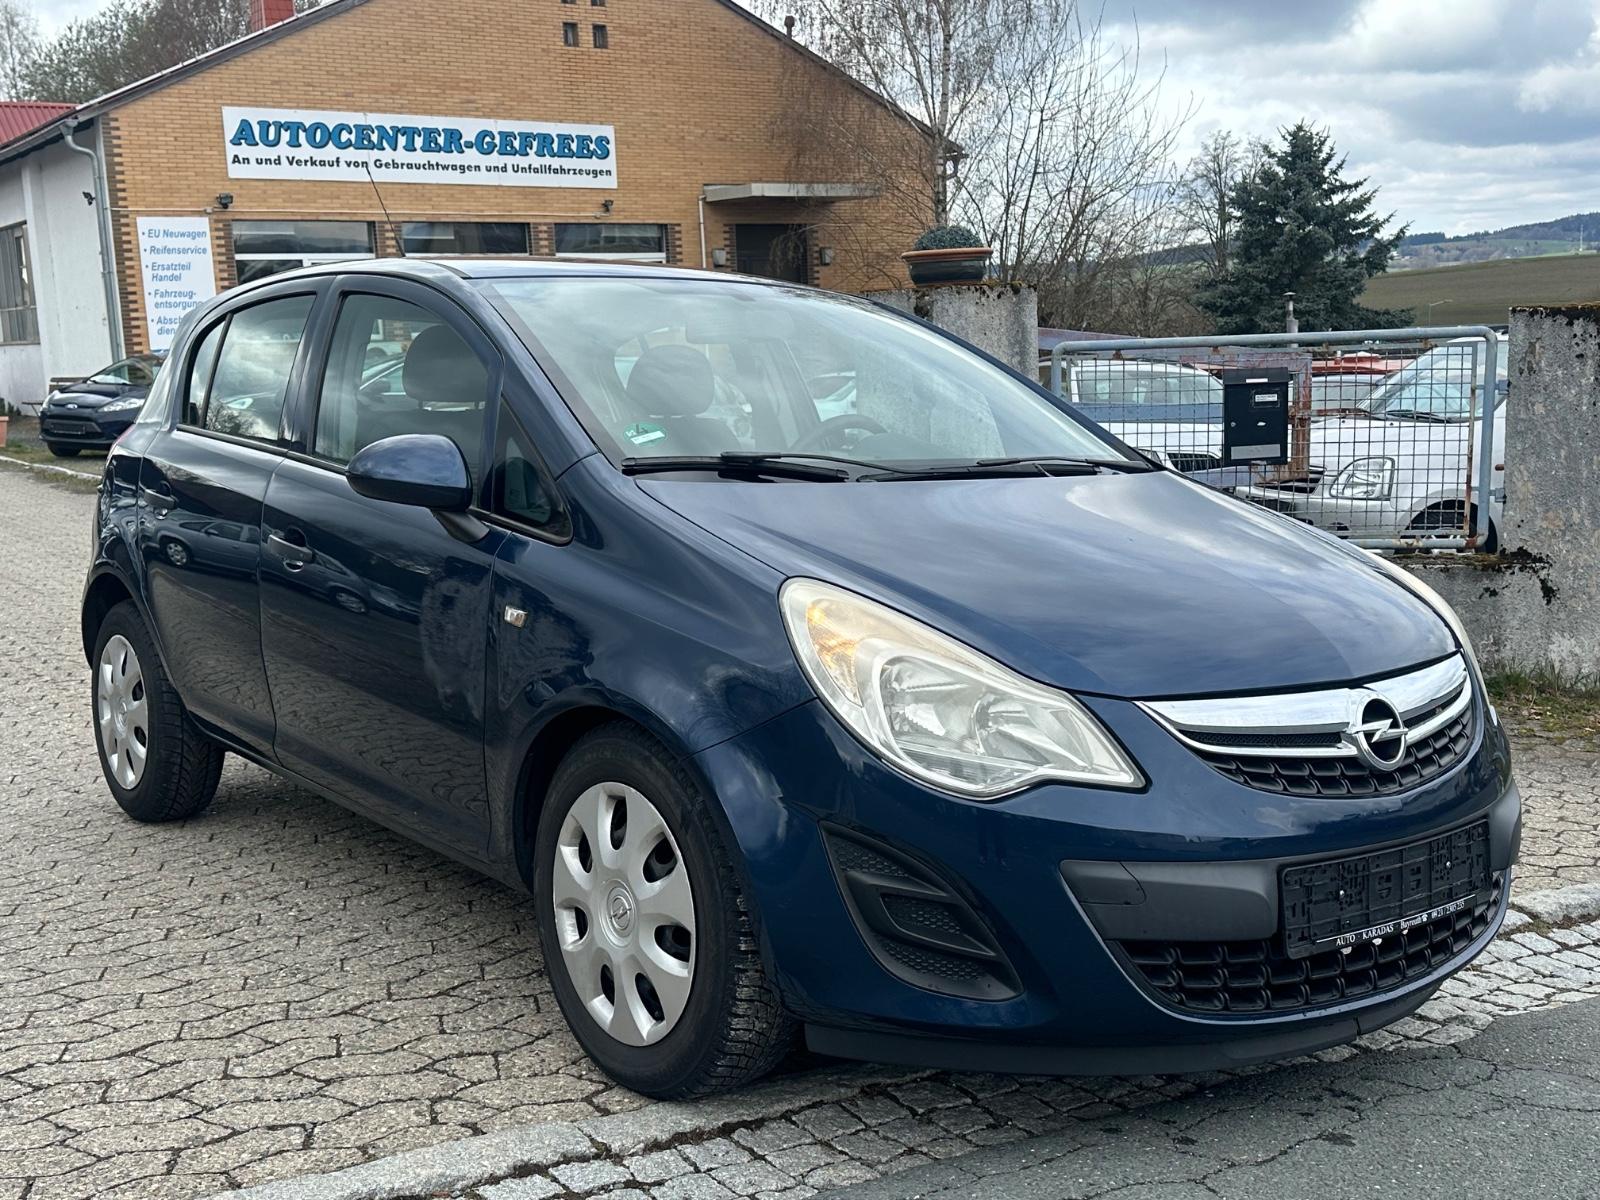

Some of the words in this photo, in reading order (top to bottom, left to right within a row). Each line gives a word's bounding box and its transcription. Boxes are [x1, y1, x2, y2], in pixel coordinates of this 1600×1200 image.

[230, 119, 611, 160] AUTOCENTER-GEFREES
[232, 154, 250, 165] An
[256, 155, 281, 166] und
[285, 156, 341, 168] Verkauf
[345, 159, 368, 169] von
[374, 159, 481, 174] Gebrauchtwagen
[485, 163, 508, 174] und
[512, 163, 612, 179] Unfallfahrzeugen
[147, 229, 160, 238] EU
[162, 229, 207, 240] Neuwagen
[149, 245, 207, 255] Reifenservice
[151, 262, 191, 271] Ersatzteil
[151, 273, 182, 282] Handel
[153, 289, 197, 299] Fahrzeug-
[1335, 934, 1356, 947] AUTO
[1362, 924, 1394, 940] KARADAS
